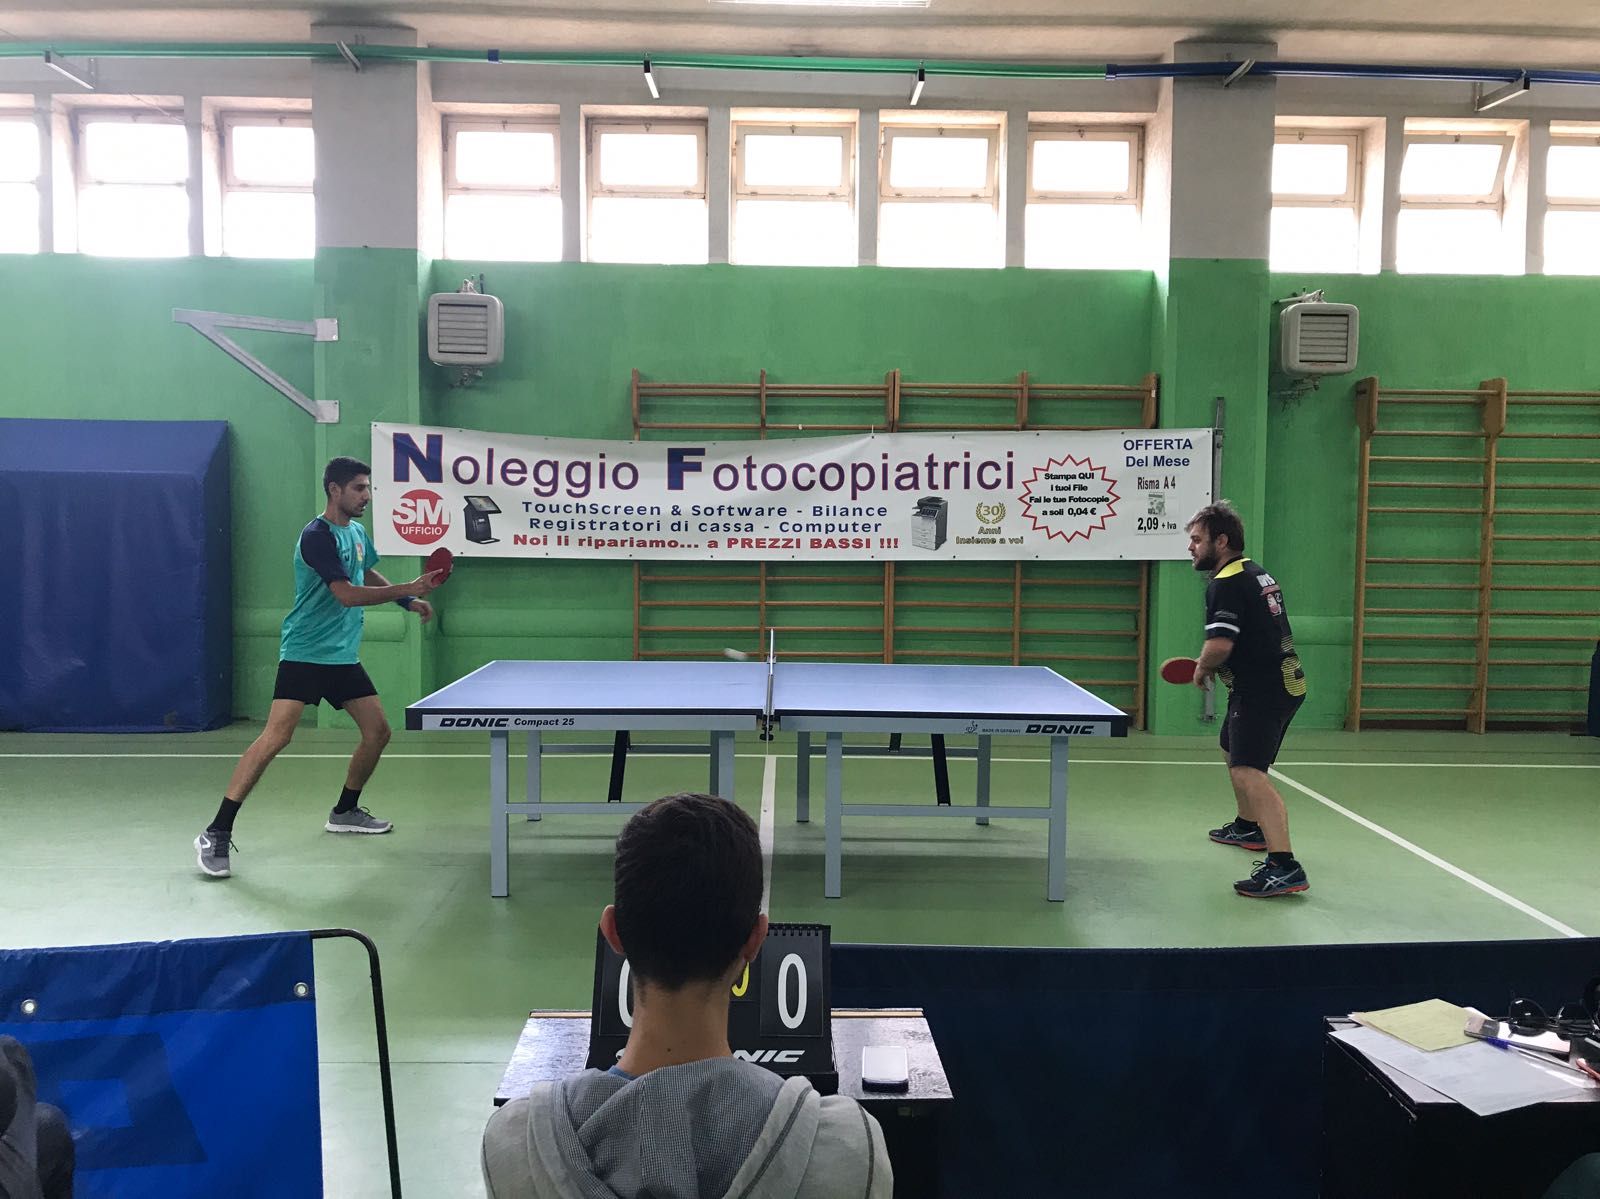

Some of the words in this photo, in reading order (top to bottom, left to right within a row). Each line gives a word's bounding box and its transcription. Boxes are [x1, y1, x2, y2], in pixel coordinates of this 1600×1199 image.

[1123, 438, 1193, 451] OFFERTA
[392, 432, 640, 499] Noleggio
[666, 447, 1014, 501] Fotocopiatrici
[1126, 456, 1148, 467] Del
[1153, 455, 1190, 467] Mese
[1044, 472, 1077, 481] Stampa
[1078, 472, 1094, 480] QUI
[1137, 477, 1159, 490] Risma
[1068, 495, 1110, 504] Fotocopie
[392, 499, 450, 526] SM
[522, 501, 661, 516] TouchScreen
[671, 505, 682, 516] &
[691, 505, 787, 518] Software
[812, 505, 888, 517] Bilance
[982, 505, 1000, 516] 30
[1067, 507, 1088, 517] 0,04
[1089, 507, 1097, 516] €
[401, 526, 442, 536] UFFICIO
[529, 518, 661, 532] Registratori
[670, 521, 689, 532] di
[698, 522, 754, 533] cassa
[779, 521, 882, 535] Computer
[978, 526, 1002, 535] Anni
[1137, 517, 1159, 533] 2,09
[1167, 522, 1177, 530] Iva
[513, 534, 548, 546] Noi
[557, 535, 569, 546] li
[578, 536, 699, 549] ripariamo...
[707, 539, 719, 549] a
[727, 537, 801, 549] PREZZI
[809, 537, 871, 549] BASSI
[879, 537, 899, 549] !!!
[955, 536, 997, 545] Insieme
[1008, 536, 1024, 545] voi
[440, 717, 509, 728] DONIC
[513, 717, 559, 728] Compact
[562, 717, 575, 726] 25
[1025, 724, 1095, 735] DONIC
[778, 953, 807, 1029] 0
[733, 1050, 805, 1063] NIC
